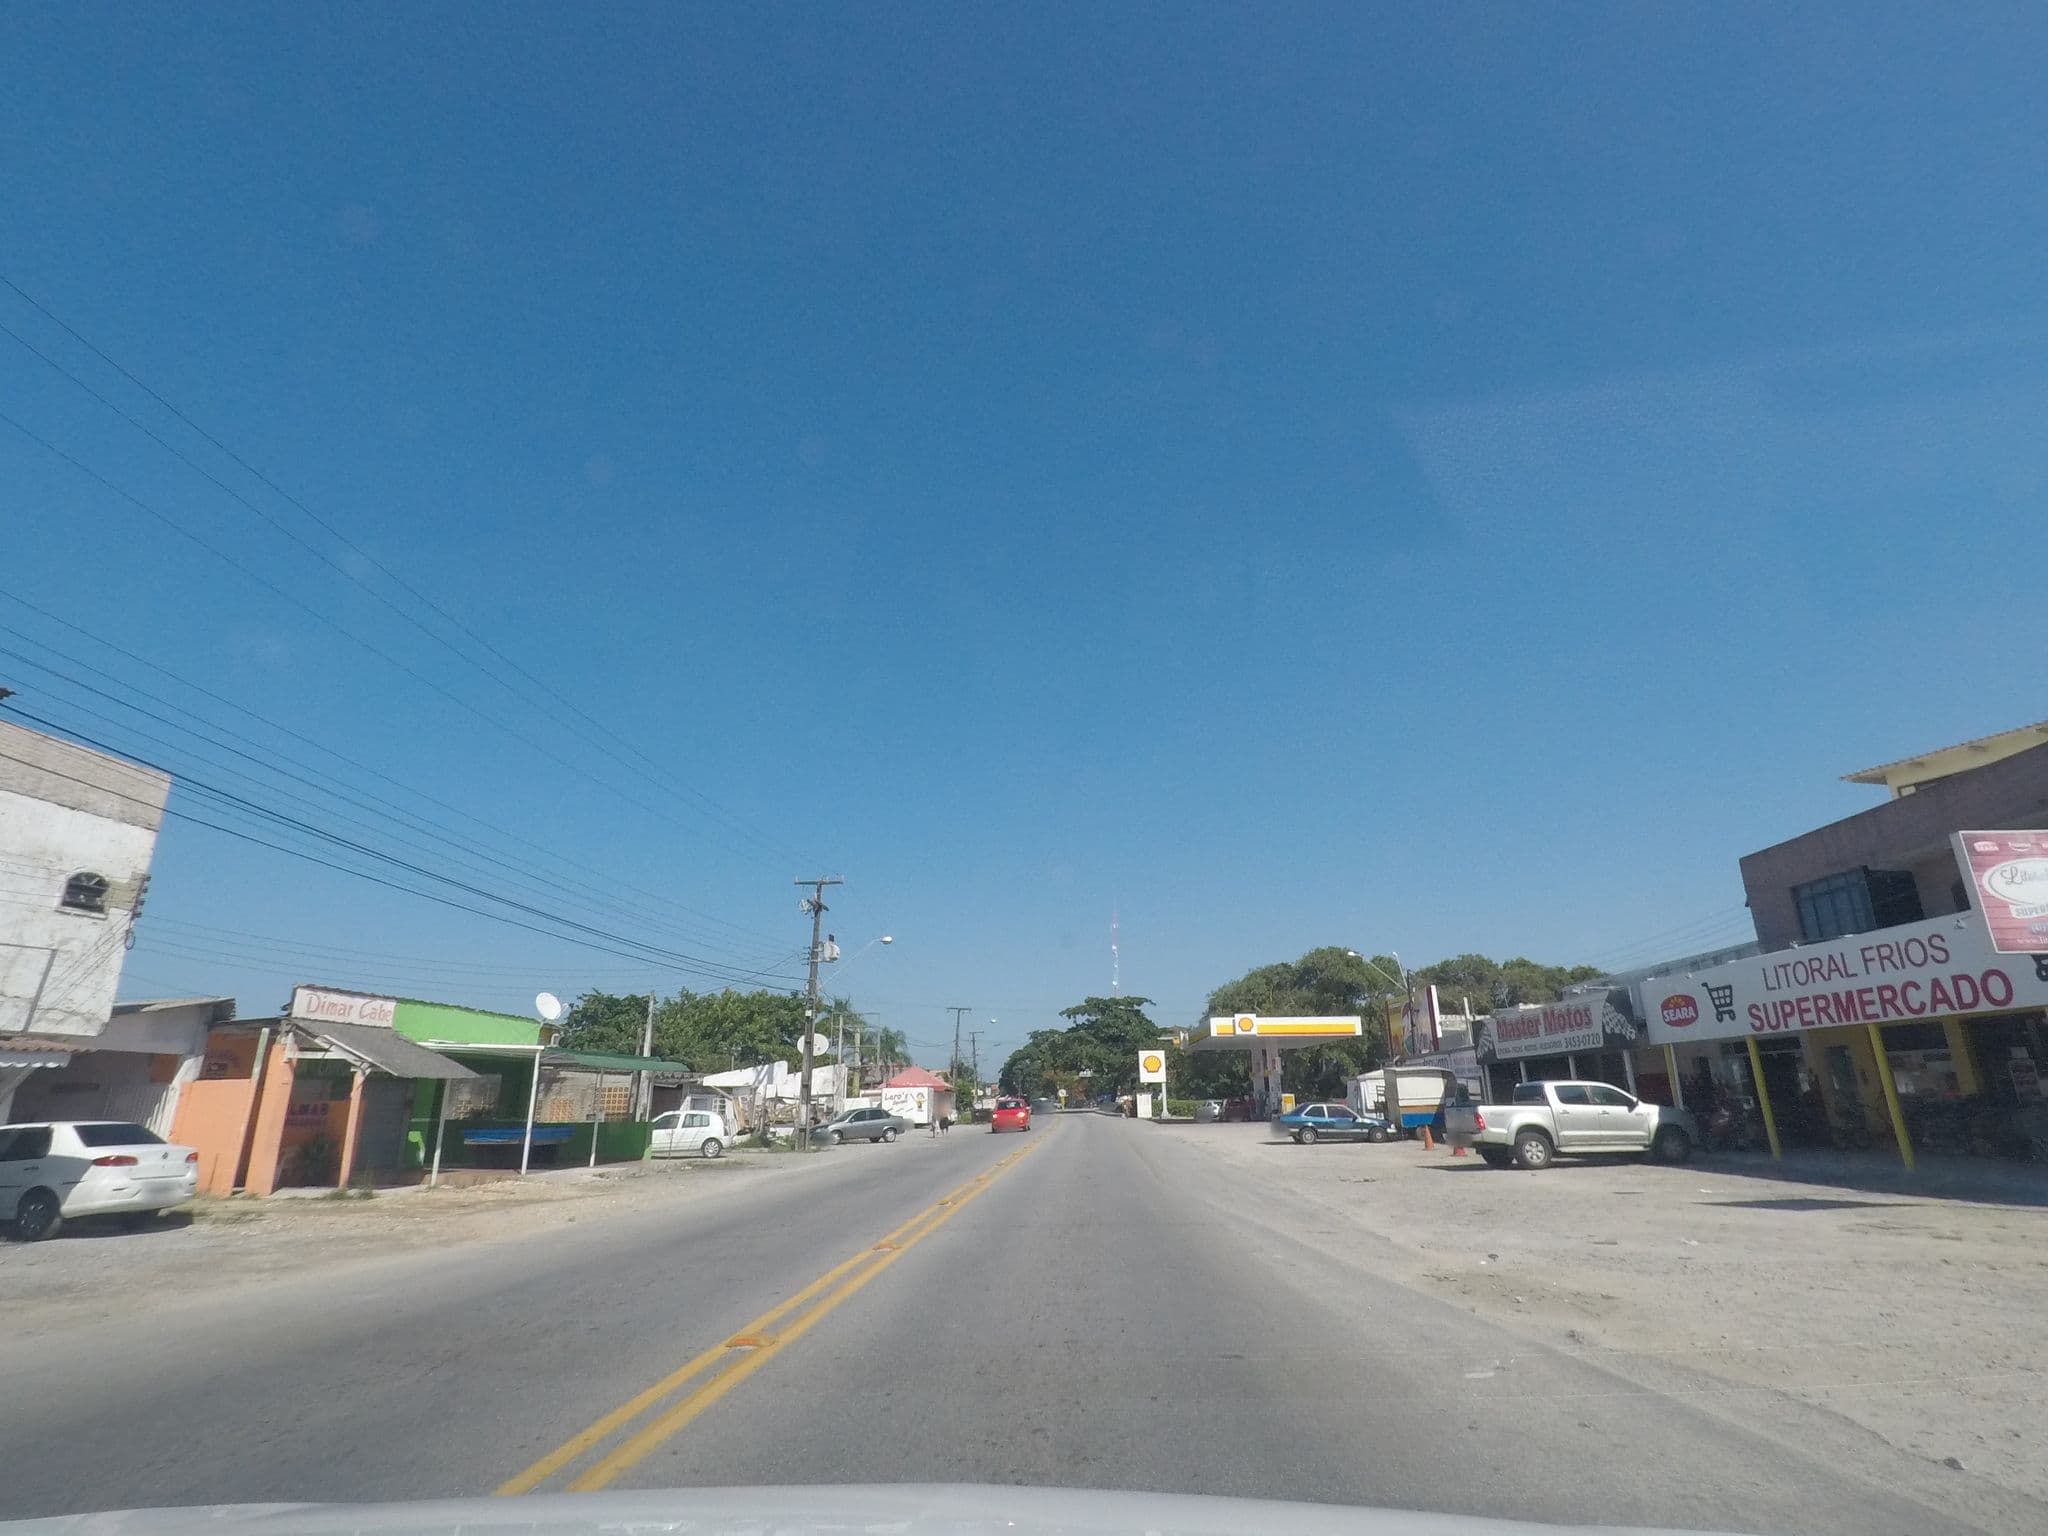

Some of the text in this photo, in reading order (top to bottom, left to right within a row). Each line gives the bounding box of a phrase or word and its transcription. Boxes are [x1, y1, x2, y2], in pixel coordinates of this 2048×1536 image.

[1762, 934, 1950, 991] LITORAL FRIOS
[306, 993, 353, 1017] Dimar
[1663, 1006, 1696, 1023] SEARA
[1747, 968, 2014, 1032] SUPERMERCADO
[1496, 1004, 1593, 1041] Master Motos
